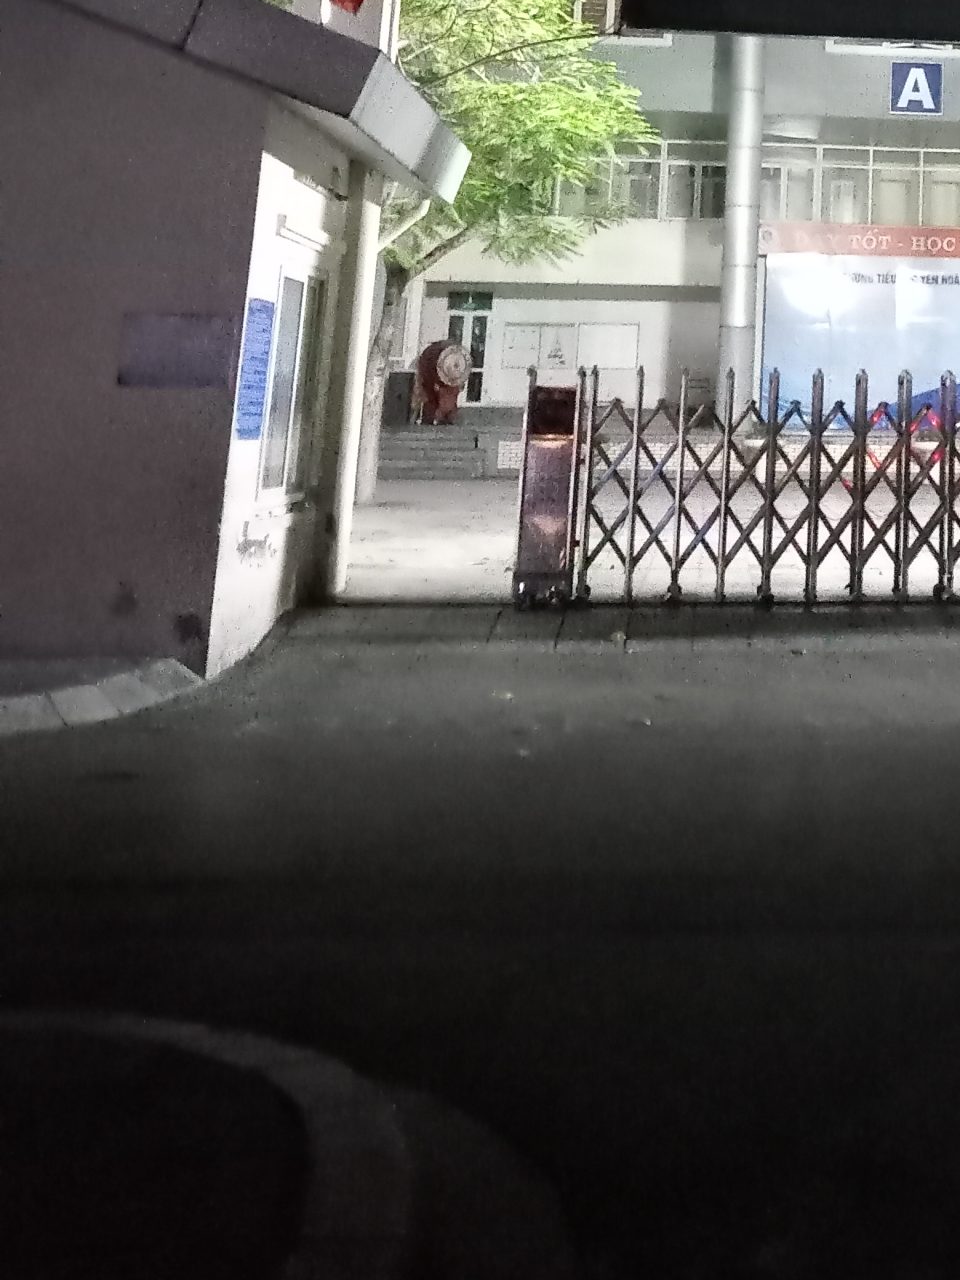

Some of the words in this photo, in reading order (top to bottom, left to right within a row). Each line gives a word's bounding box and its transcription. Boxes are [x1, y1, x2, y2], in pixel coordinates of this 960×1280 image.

[896, 66, 937, 110] A
[848, 228, 891, 251] TỐT
[911, 235, 956, 255] HỌC
